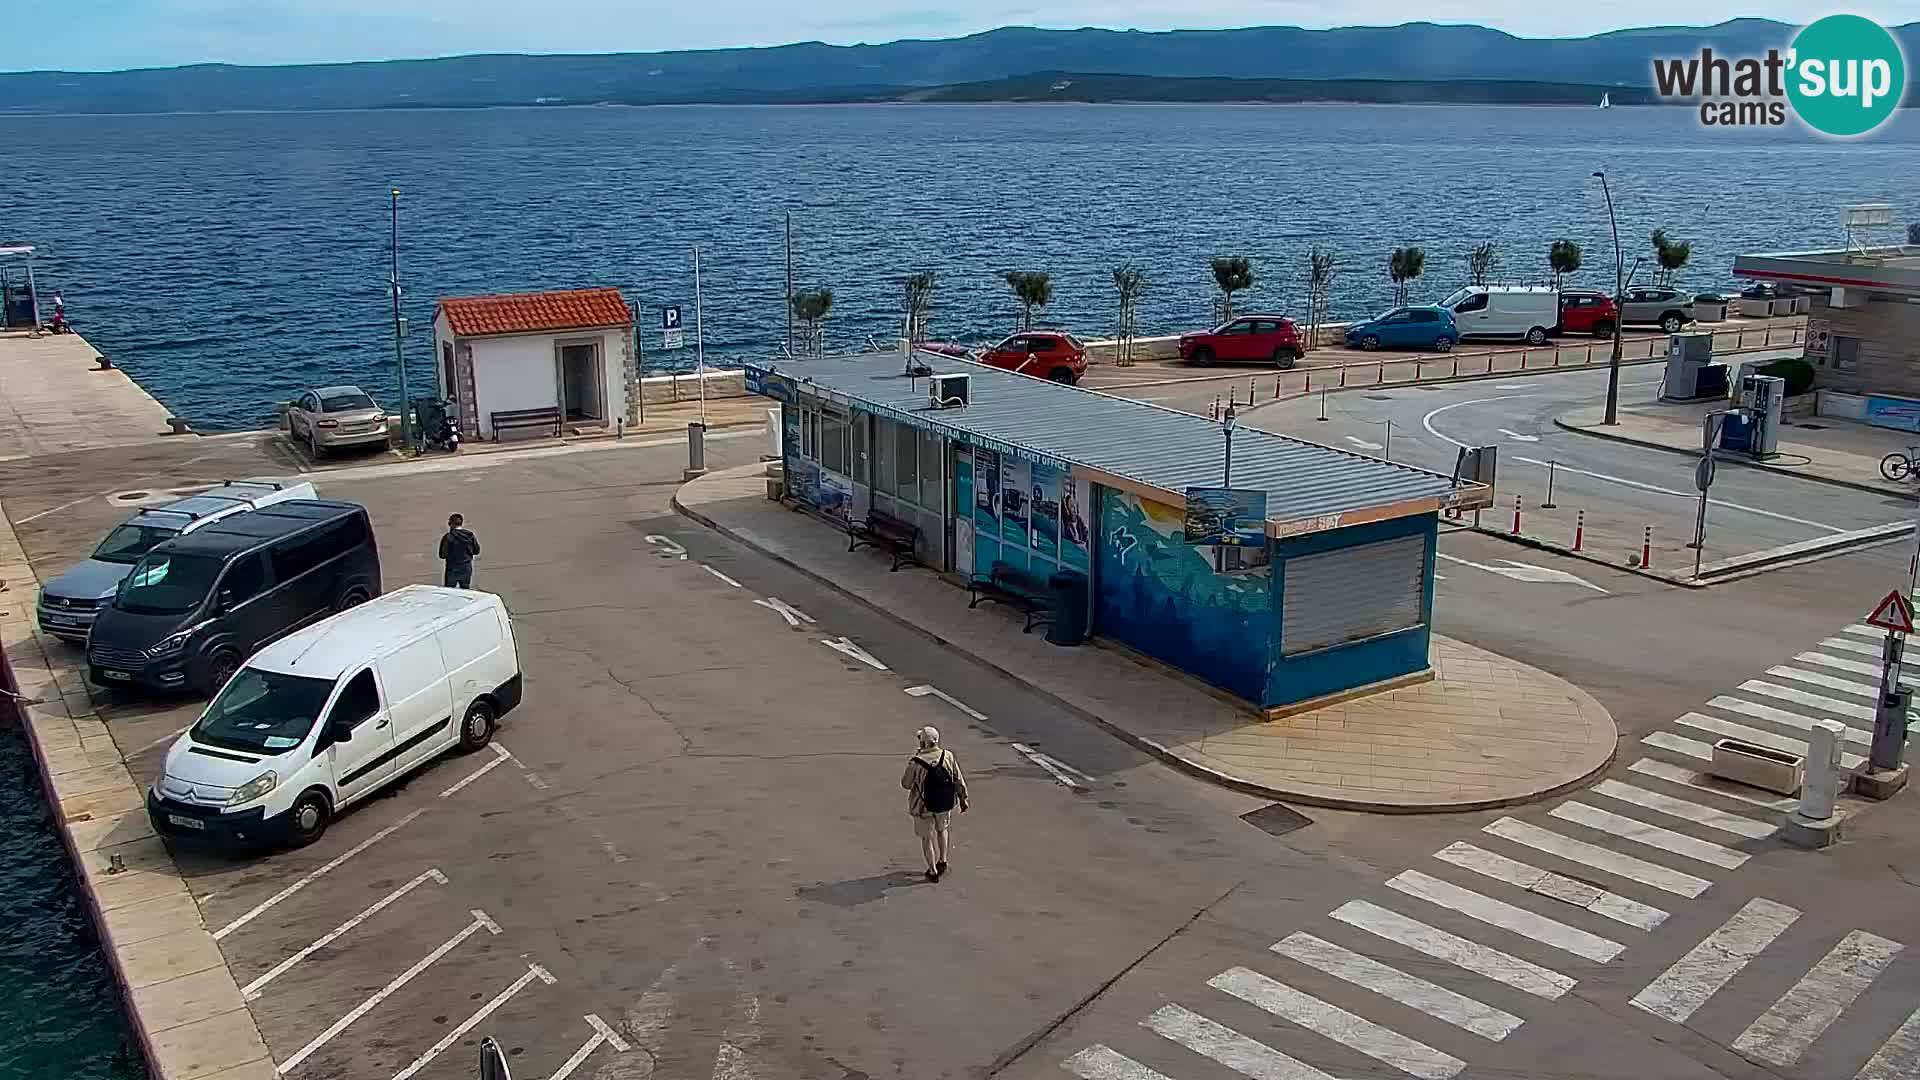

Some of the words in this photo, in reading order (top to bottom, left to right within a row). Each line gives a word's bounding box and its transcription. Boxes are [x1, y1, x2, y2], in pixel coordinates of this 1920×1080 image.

[667, 309, 677, 326] P
[969, 433, 984, 447] BUS
[984, 438, 1014, 456] STATION
[1016, 448, 1041, 464] TICKET
[1041, 456, 1067, 471] OFFICE
